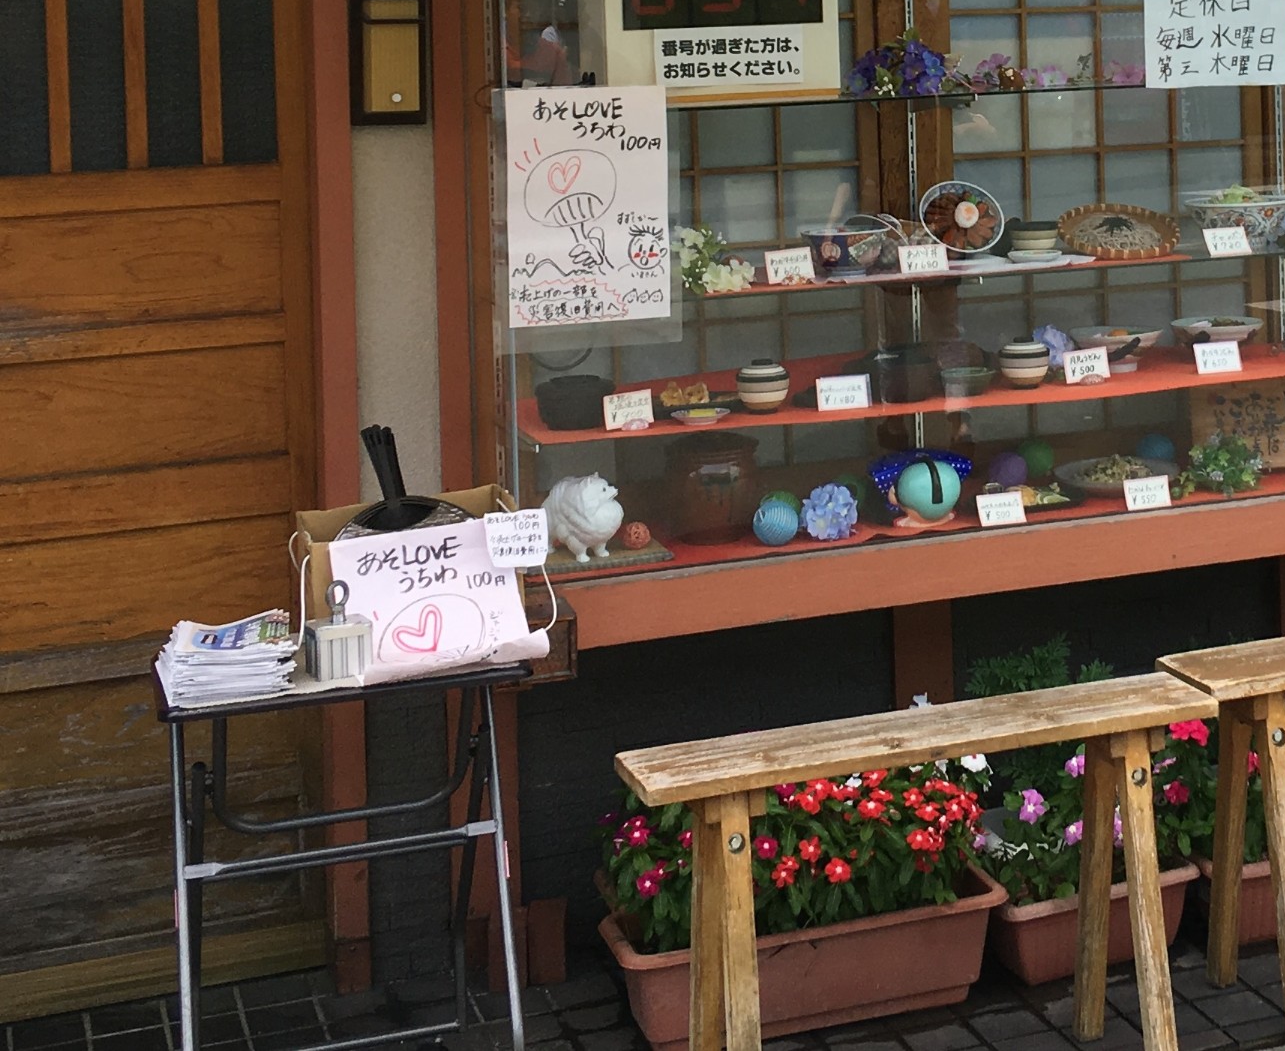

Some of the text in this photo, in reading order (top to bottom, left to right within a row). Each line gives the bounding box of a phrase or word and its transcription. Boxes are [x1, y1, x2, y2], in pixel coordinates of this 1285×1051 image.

[661, 37, 801, 57] 番号が過ぎた方は、
[662, 60, 801, 80] お知らせください。
[572, 121, 626, 142] うちわ
[620, 136, 662, 151] 100円
[356, 535, 464, 576] あそLOVE
[398, 564, 459, 594] うちわ
[465, 571, 507, 590] 100円
